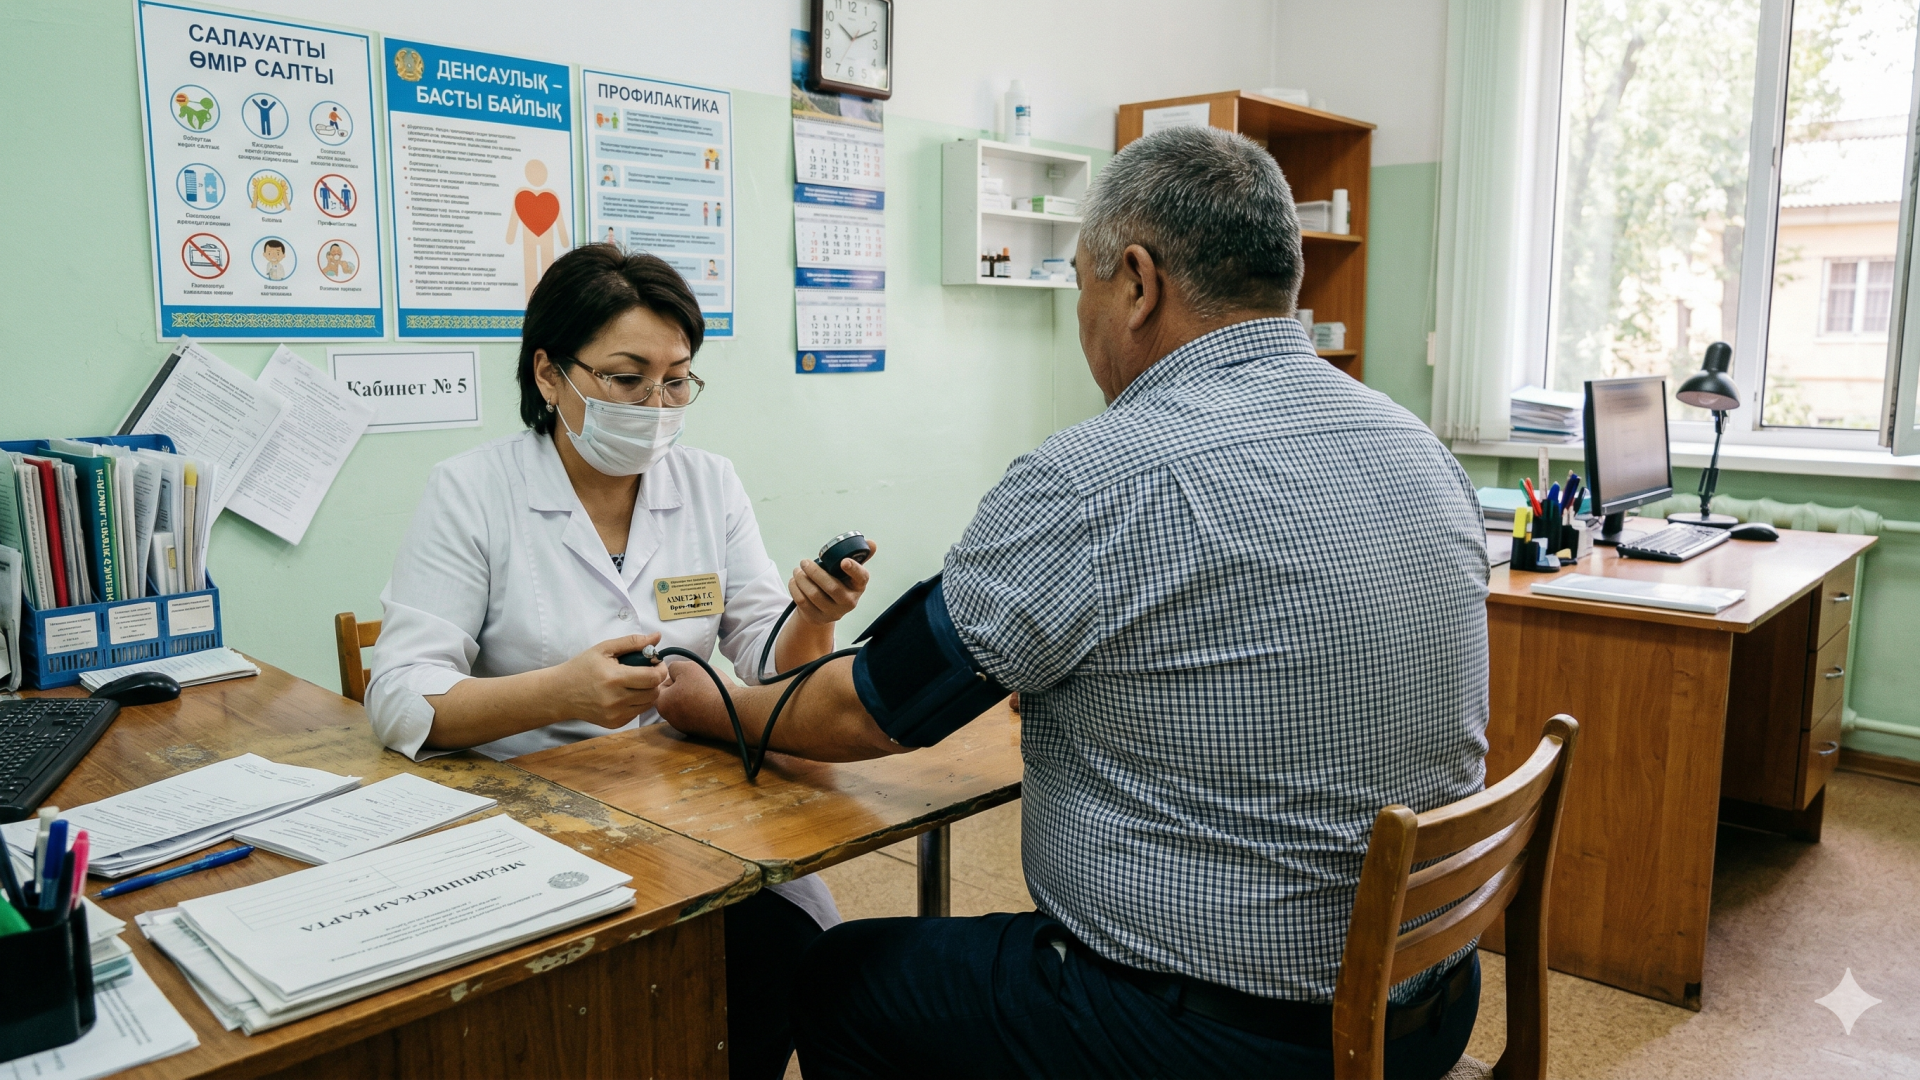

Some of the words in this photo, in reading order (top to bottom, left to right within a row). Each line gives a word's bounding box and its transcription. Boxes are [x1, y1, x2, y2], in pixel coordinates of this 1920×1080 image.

[825, 10, 835, 22] 10
[848, 1, 857, 13] 12
[188, 23, 326, 60] САЛАУАТТЫ
[189, 50, 247, 73] ӨМІР
[254, 58, 334, 85] САЛТЫ
[437, 59, 549, 94] ДЕНСАУЛЫҚ
[416, 85, 482, 110] БАСТЫ
[488, 93, 562, 123] БАЙЛЫҚ
[598, 83, 720, 115] ПРОФИЛАКТИКА
[347, 380, 427, 397] Кабинет
[432, 378, 452, 395] №
[457, 377, 467, 394] 5
[300, 909, 371, 932] КАРТА
